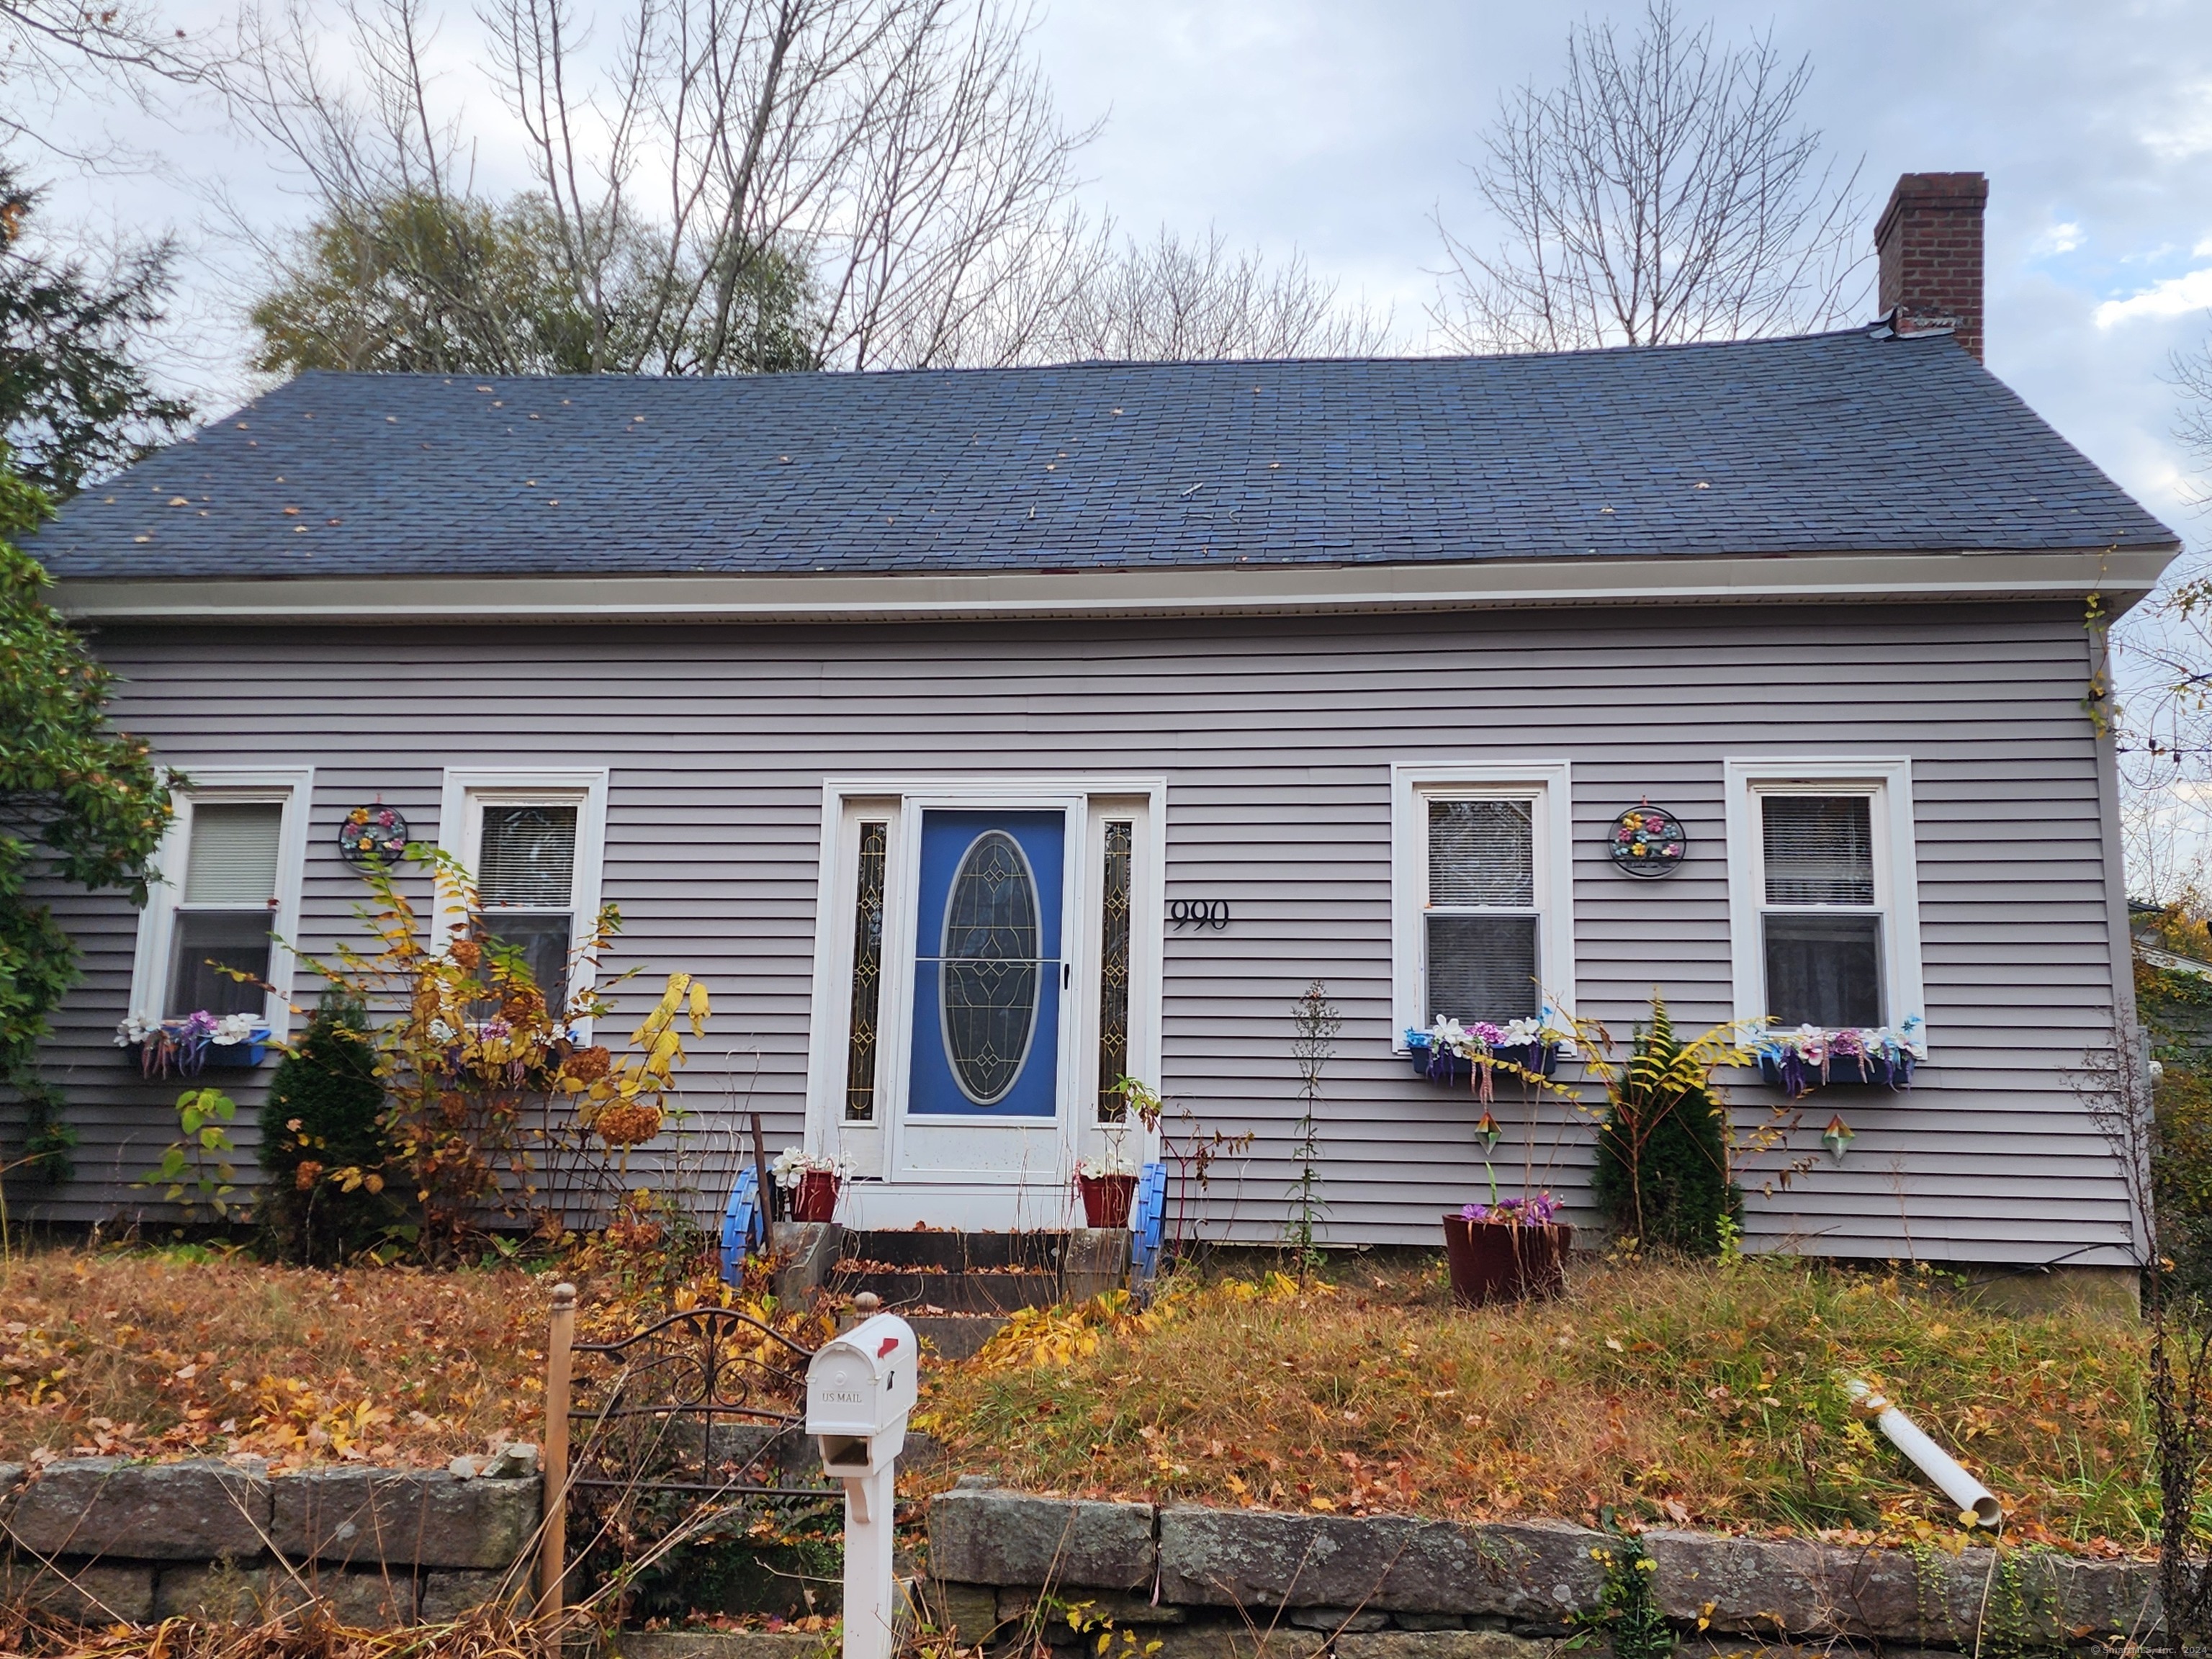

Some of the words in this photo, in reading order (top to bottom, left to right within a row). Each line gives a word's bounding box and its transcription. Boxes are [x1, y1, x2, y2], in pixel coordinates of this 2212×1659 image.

[1171, 900, 1229, 931] 990
[822, 1393, 835, 1402] US
[837, 1393, 862, 1403] MAIL
